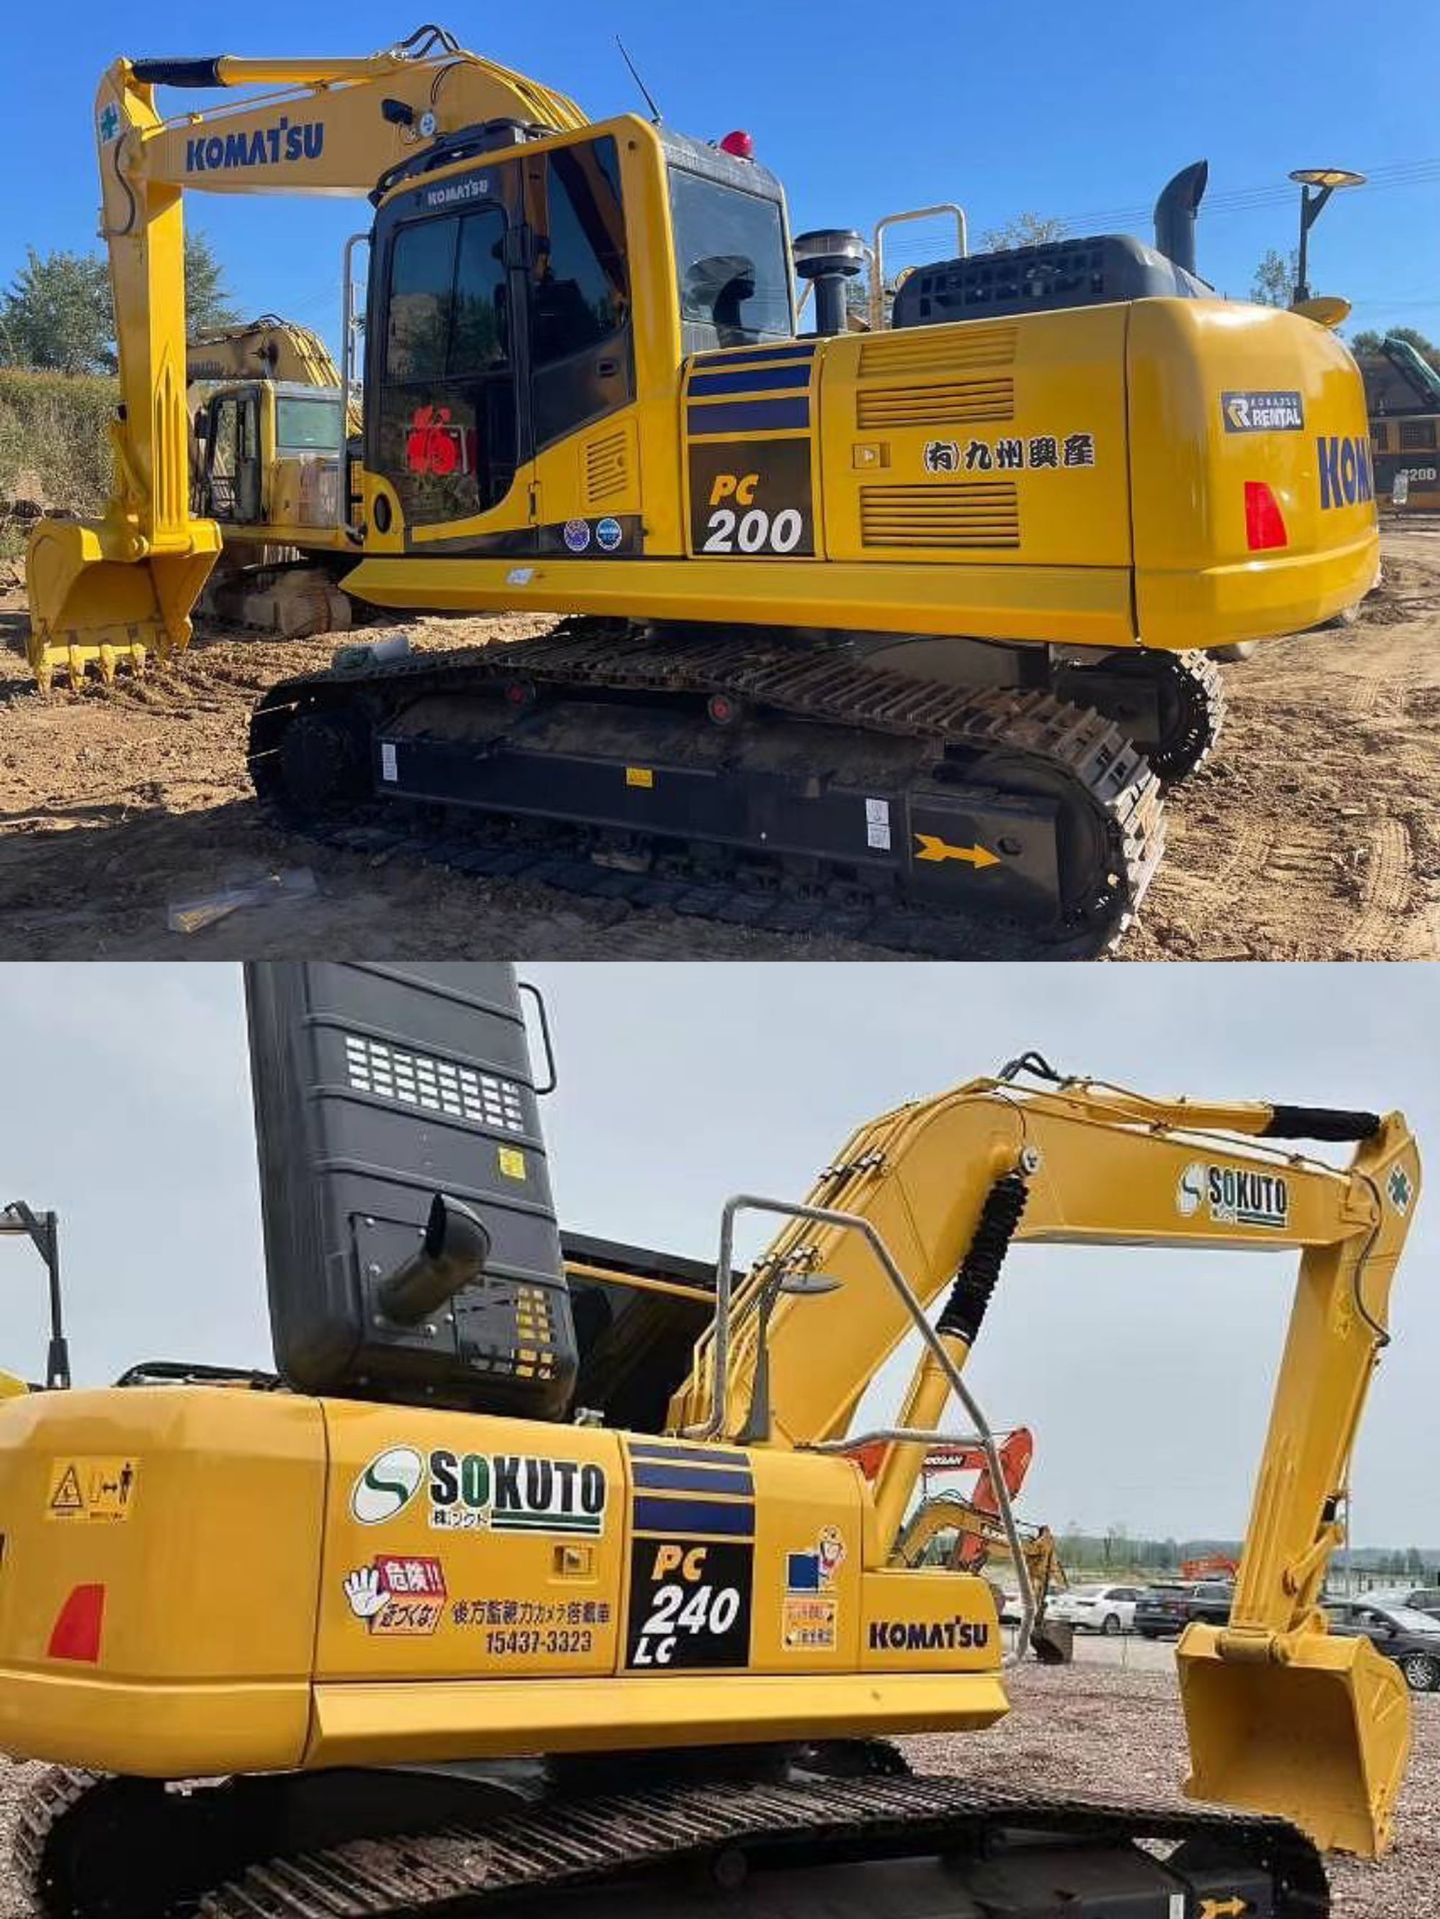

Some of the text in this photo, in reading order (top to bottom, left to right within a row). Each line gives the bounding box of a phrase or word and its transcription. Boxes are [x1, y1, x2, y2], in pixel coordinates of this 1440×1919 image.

[186, 117, 324, 172] KOMATSU
[427, 179, 488, 206] KOMATSU
[1252, 407, 1301, 428] RENTAL
[709, 473, 759, 506] PC
[703, 508, 802, 553] 200
[1208, 1166, 1288, 1215] SOKUTO
[429, 1450, 606, 1514] SOKUTO
[651, 1545, 707, 1582] PC
[642, 1584, 740, 1635] 240
[486, 1629, 593, 1655] 15437-3323
[633, 1636, 678, 1665] LC
[868, 1615, 989, 1650] KOMATSU
